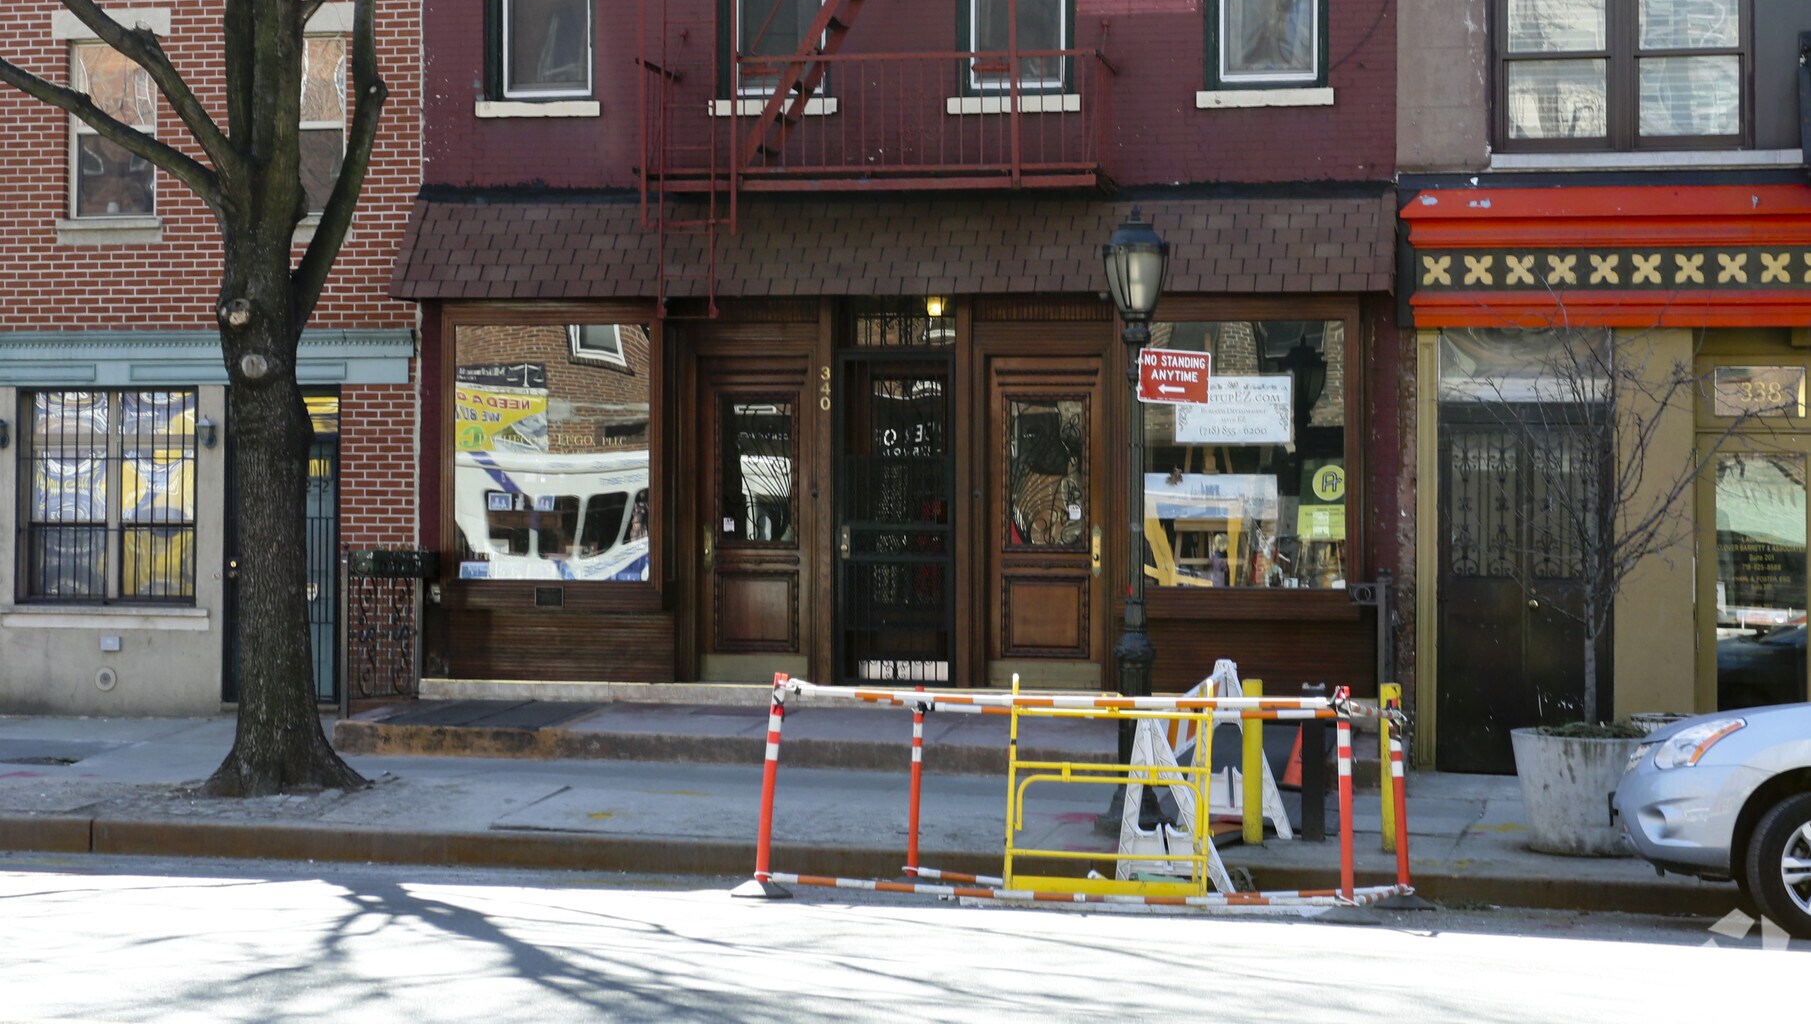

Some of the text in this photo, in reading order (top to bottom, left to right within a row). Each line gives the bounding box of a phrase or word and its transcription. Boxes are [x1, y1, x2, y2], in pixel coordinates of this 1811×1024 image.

[1144, 354, 1206, 369] NO STANDING
[1151, 369, 1199, 383] ANYTIME
[820, 366, 831, 411] 340
[1740, 381, 1782, 403] 338
[602, 436, 628, 447] PLLC
